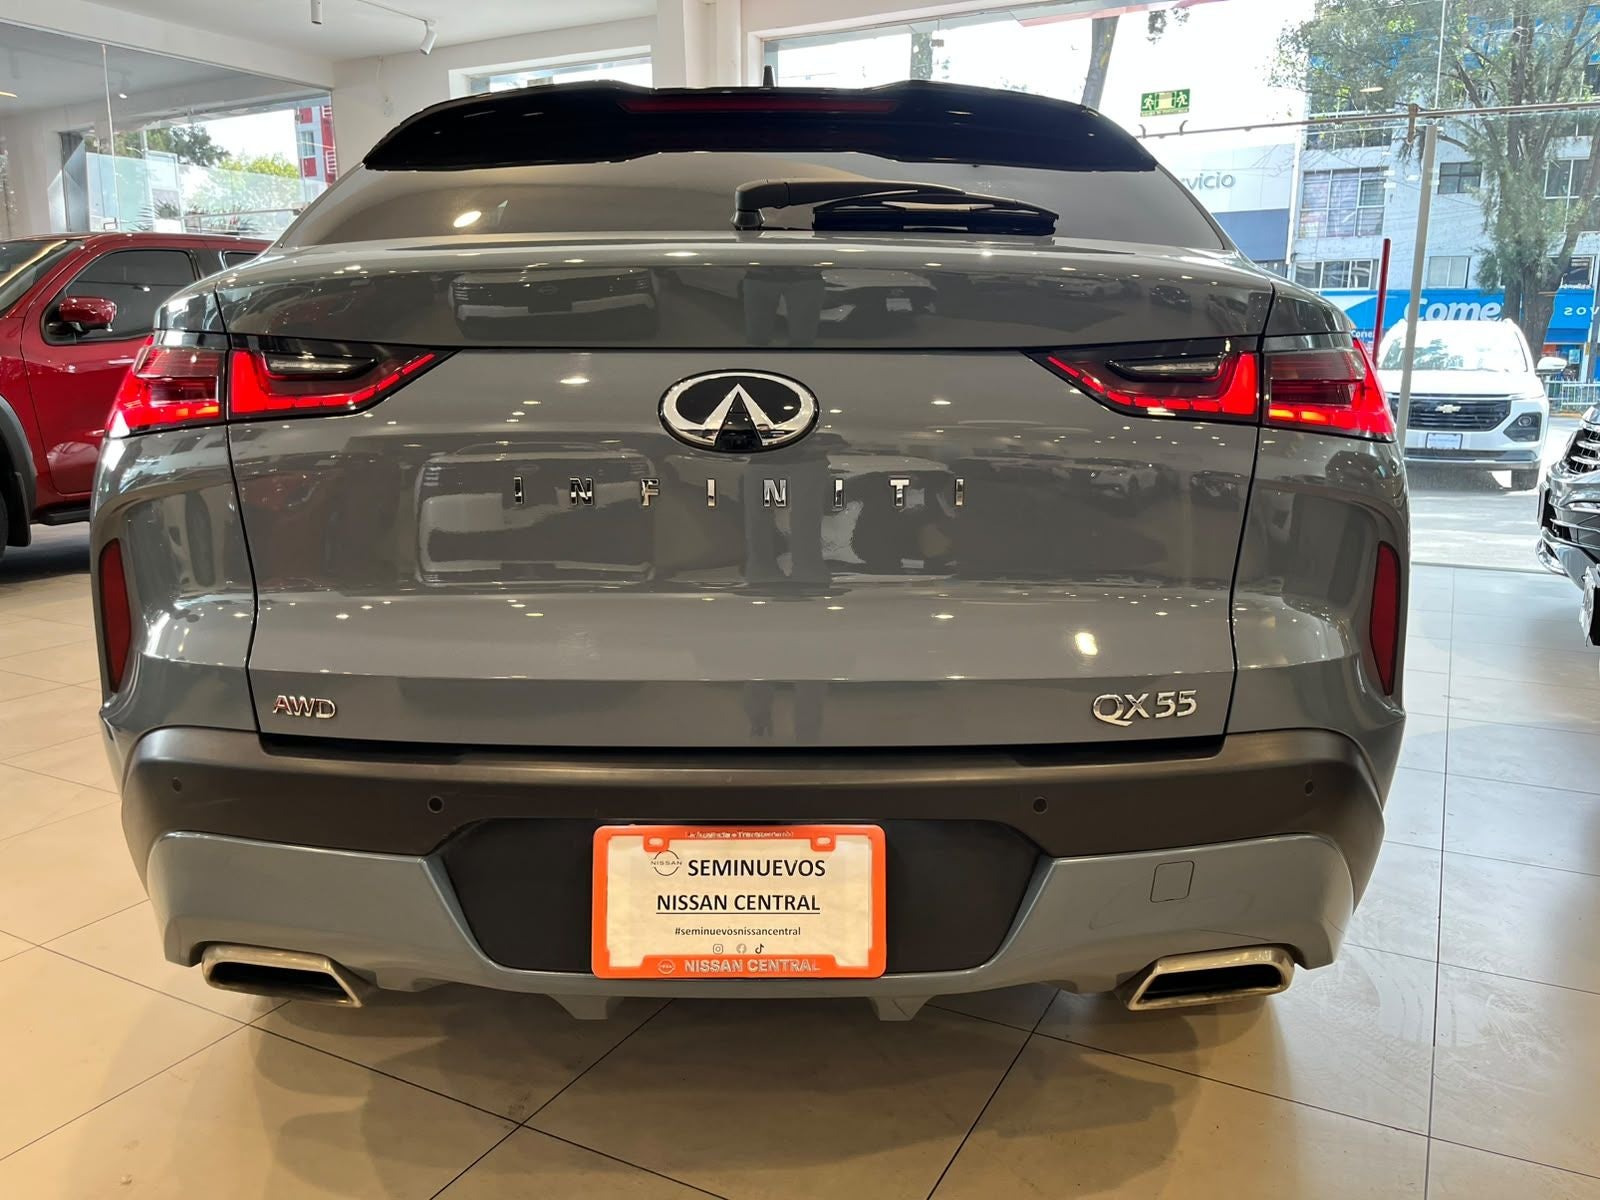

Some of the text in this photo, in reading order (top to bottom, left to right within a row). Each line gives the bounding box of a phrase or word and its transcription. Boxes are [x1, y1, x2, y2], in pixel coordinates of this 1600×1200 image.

[1180, 171, 1236, 190] vicio
[1404, 298, 1504, 321] Come
[513, 477, 965, 507] INFINITI
[272, 694, 336, 719] AWD
[1092, 689, 1197, 726] QX55
[687, 858, 826, 878] SEMINUEVOS
[656, 893, 821, 912] NISSAN CENTRAL
[674, 926, 801, 937] #seminuevosnissancentral
[684, 959, 744, 973] NISSAN
[747, 959, 821, 973] CENTRAL
